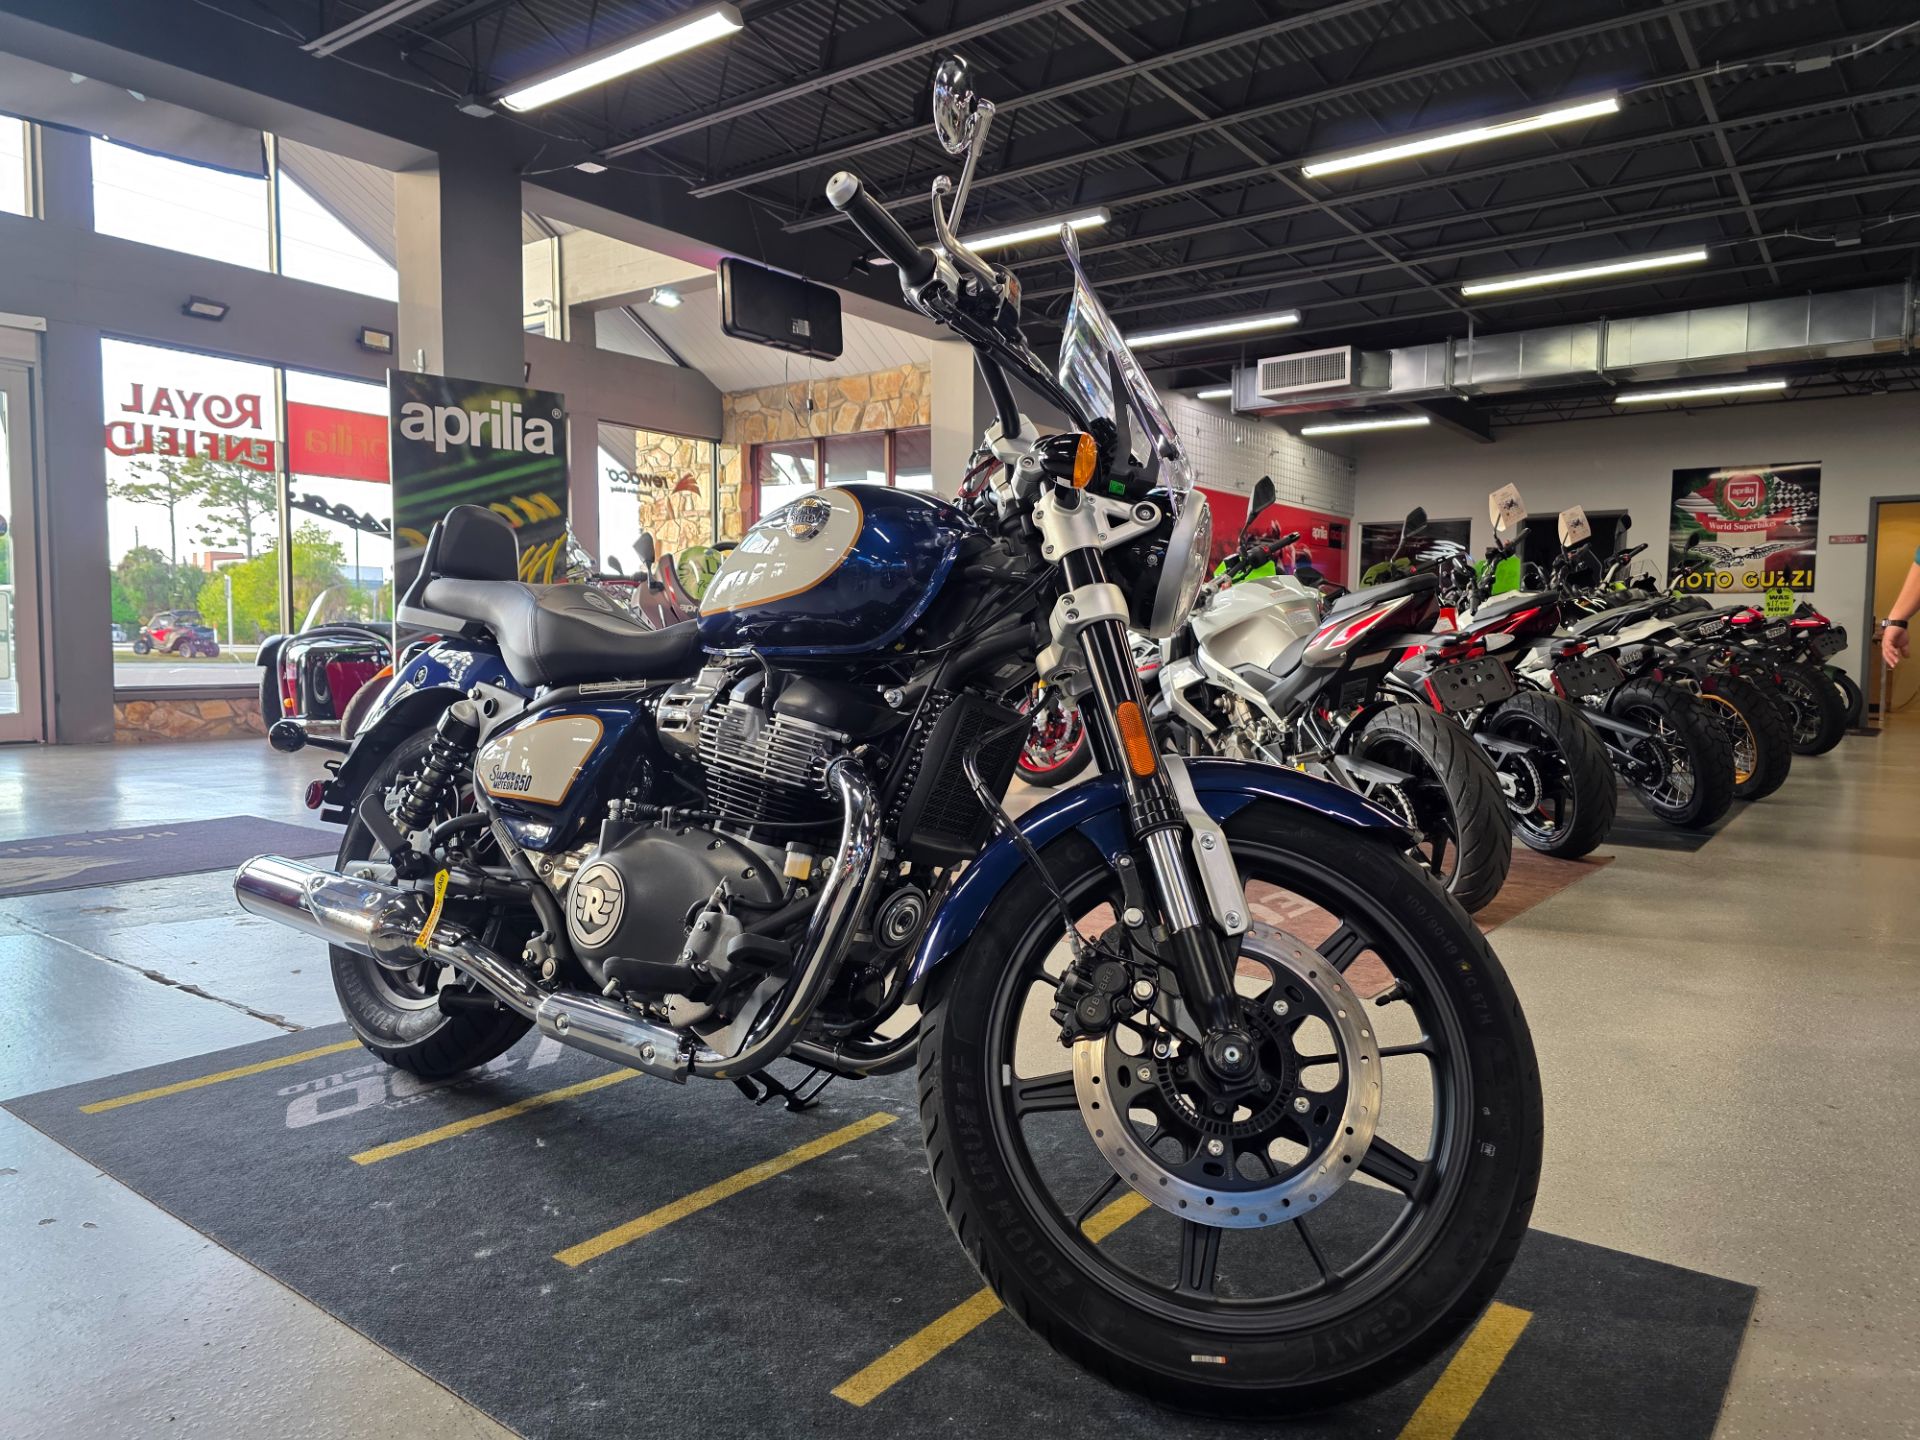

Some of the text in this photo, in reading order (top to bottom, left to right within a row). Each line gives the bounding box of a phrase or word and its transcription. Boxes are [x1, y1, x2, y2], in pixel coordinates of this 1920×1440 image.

[400, 401, 554, 455] aprilia
[1732, 486, 1755, 497] aprilia
[1709, 520, 1777, 531] World Superbikes
[1679, 571, 1734, 588] OTO
[490, 764, 516, 782] Super
[514, 774, 533, 792] 650
